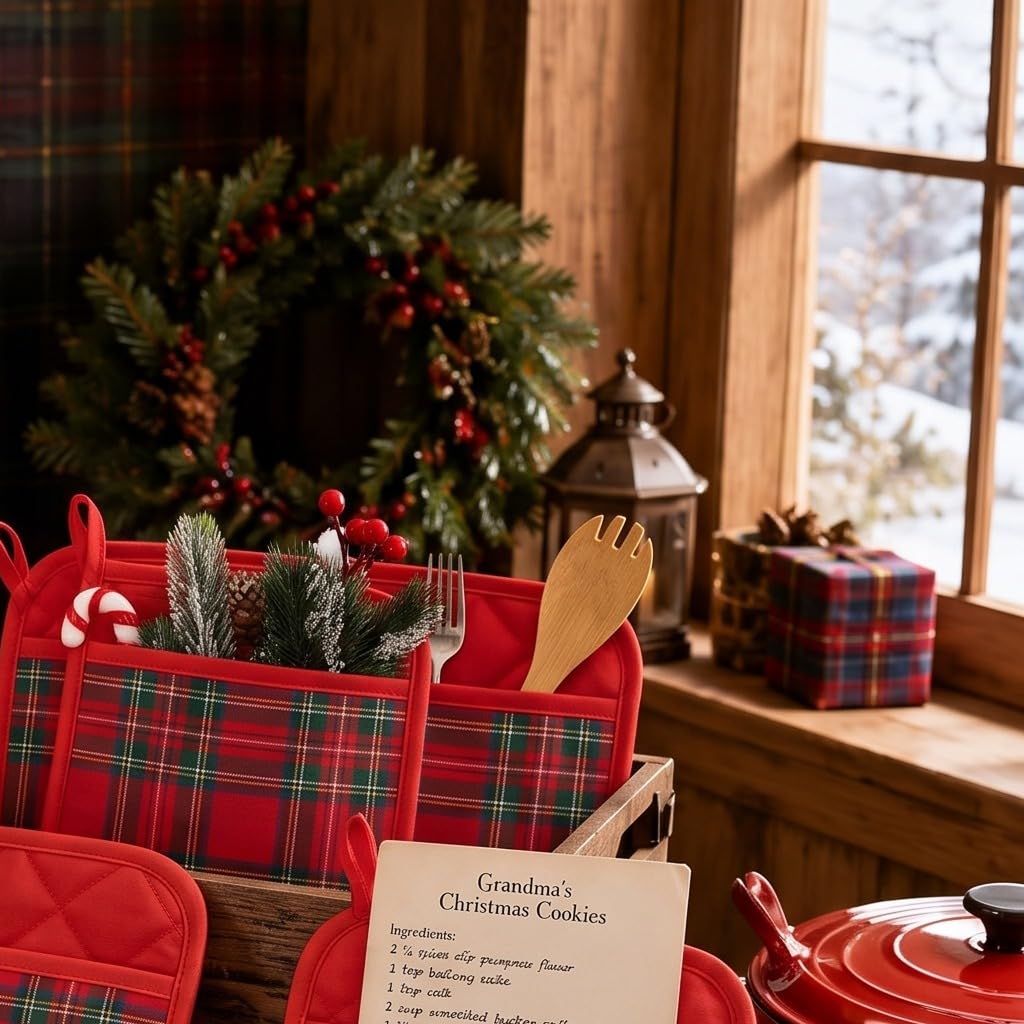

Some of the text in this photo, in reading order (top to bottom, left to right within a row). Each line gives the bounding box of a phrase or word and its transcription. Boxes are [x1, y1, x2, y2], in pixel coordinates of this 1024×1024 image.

[477, 873, 572, 898] Grandma's
[439, 892, 606, 924] Christmas Cookies
[390, 924, 455, 942] Ingredients:
[390, 944, 397, 954] 2
[389, 964, 395, 973] 1
[387, 983, 393, 992] 1
[385, 1002, 392, 1011] 2
